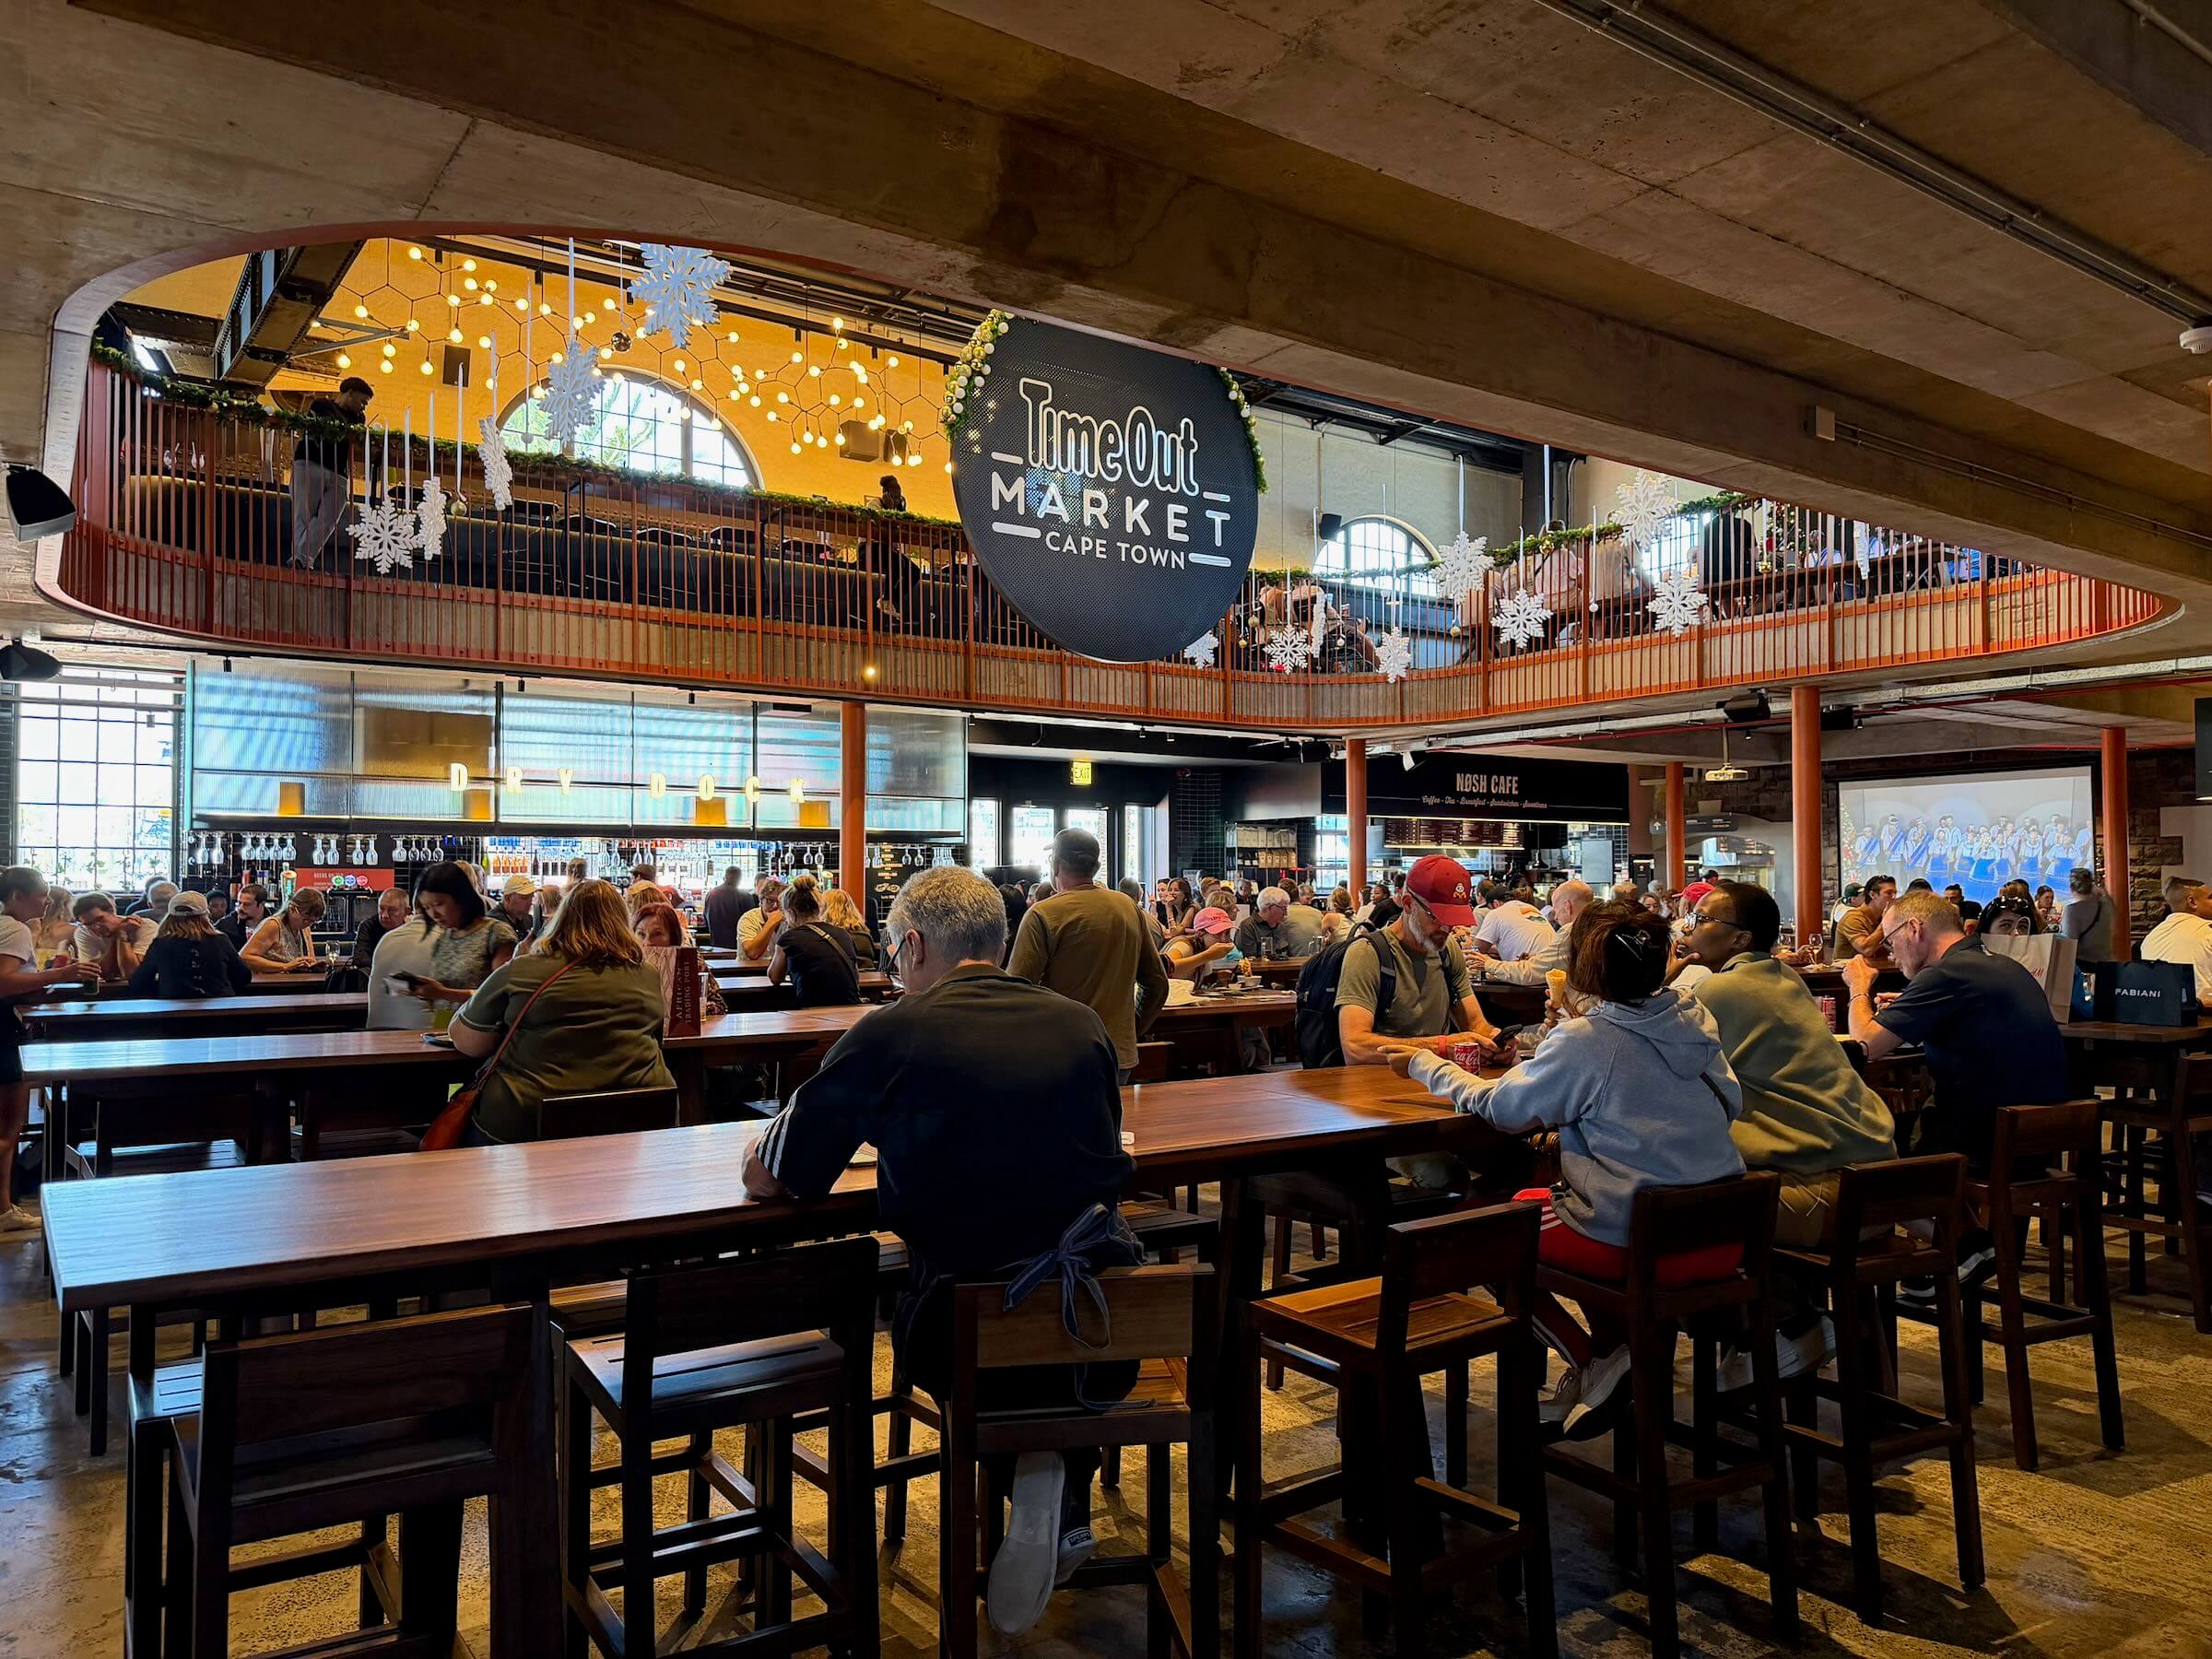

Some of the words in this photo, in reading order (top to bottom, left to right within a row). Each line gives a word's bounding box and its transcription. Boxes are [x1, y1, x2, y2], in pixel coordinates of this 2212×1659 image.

[991, 471, 1230, 547] MARKET
[1045, 531, 1107, 559] CAPE
[1117, 541, 1185, 571] TOWN
[450, 762, 573, 795] DRY
[650, 772, 805, 804] DOCK
[1074, 767, 1090, 779] EXIT
[1491, 775, 1519, 794] CAFE
[2115, 988, 2161, 997] FABIANI
